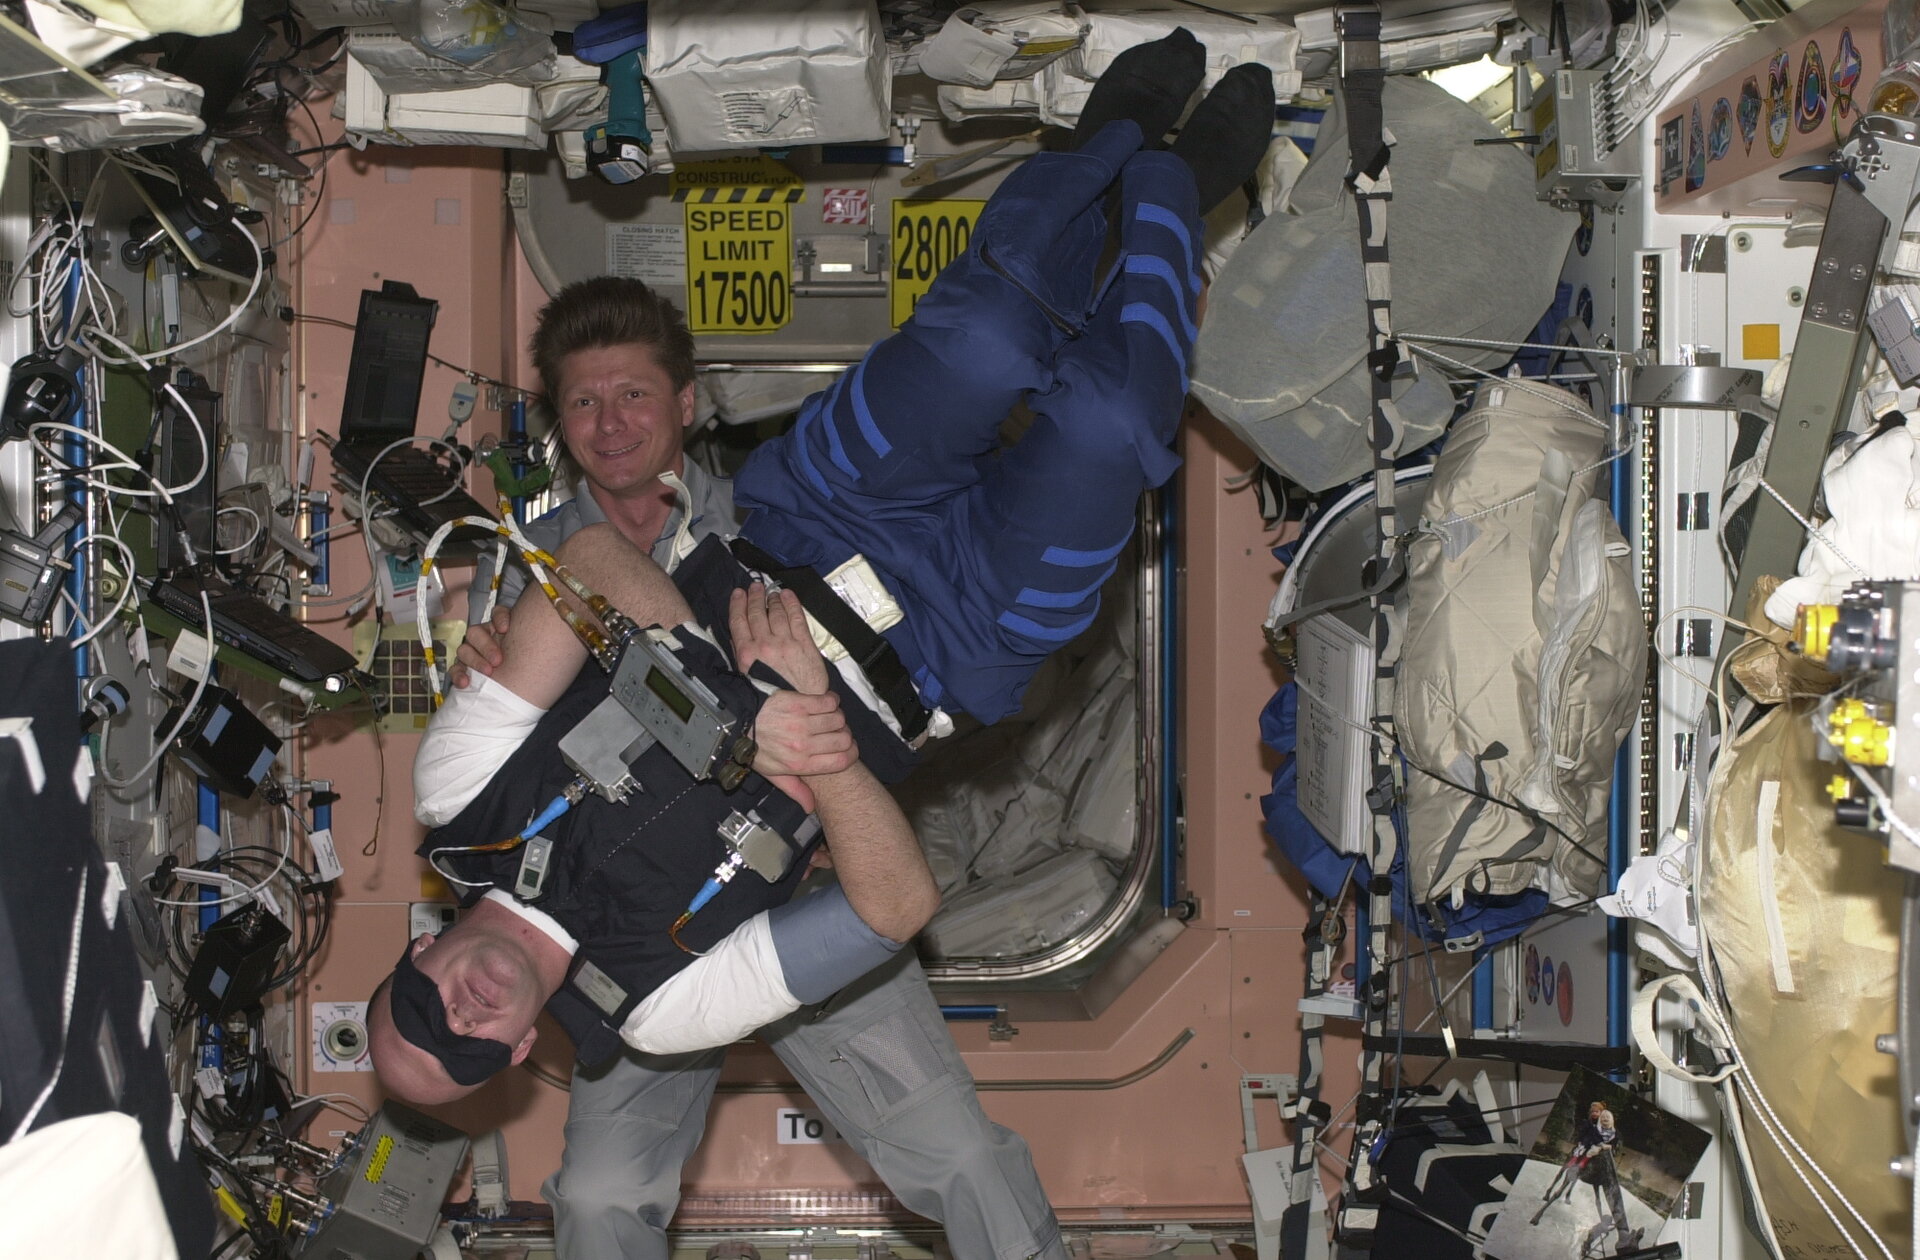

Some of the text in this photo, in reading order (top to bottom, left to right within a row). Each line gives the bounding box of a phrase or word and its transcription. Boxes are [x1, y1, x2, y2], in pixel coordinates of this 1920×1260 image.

[830, 197, 861, 216] EXIT
[690, 210, 784, 232] SPEED
[703, 240, 774, 260] LIMIT
[897, 215, 970, 281] 2800
[694, 270, 785, 325] 17500
[784, 1113, 824, 1139] To
